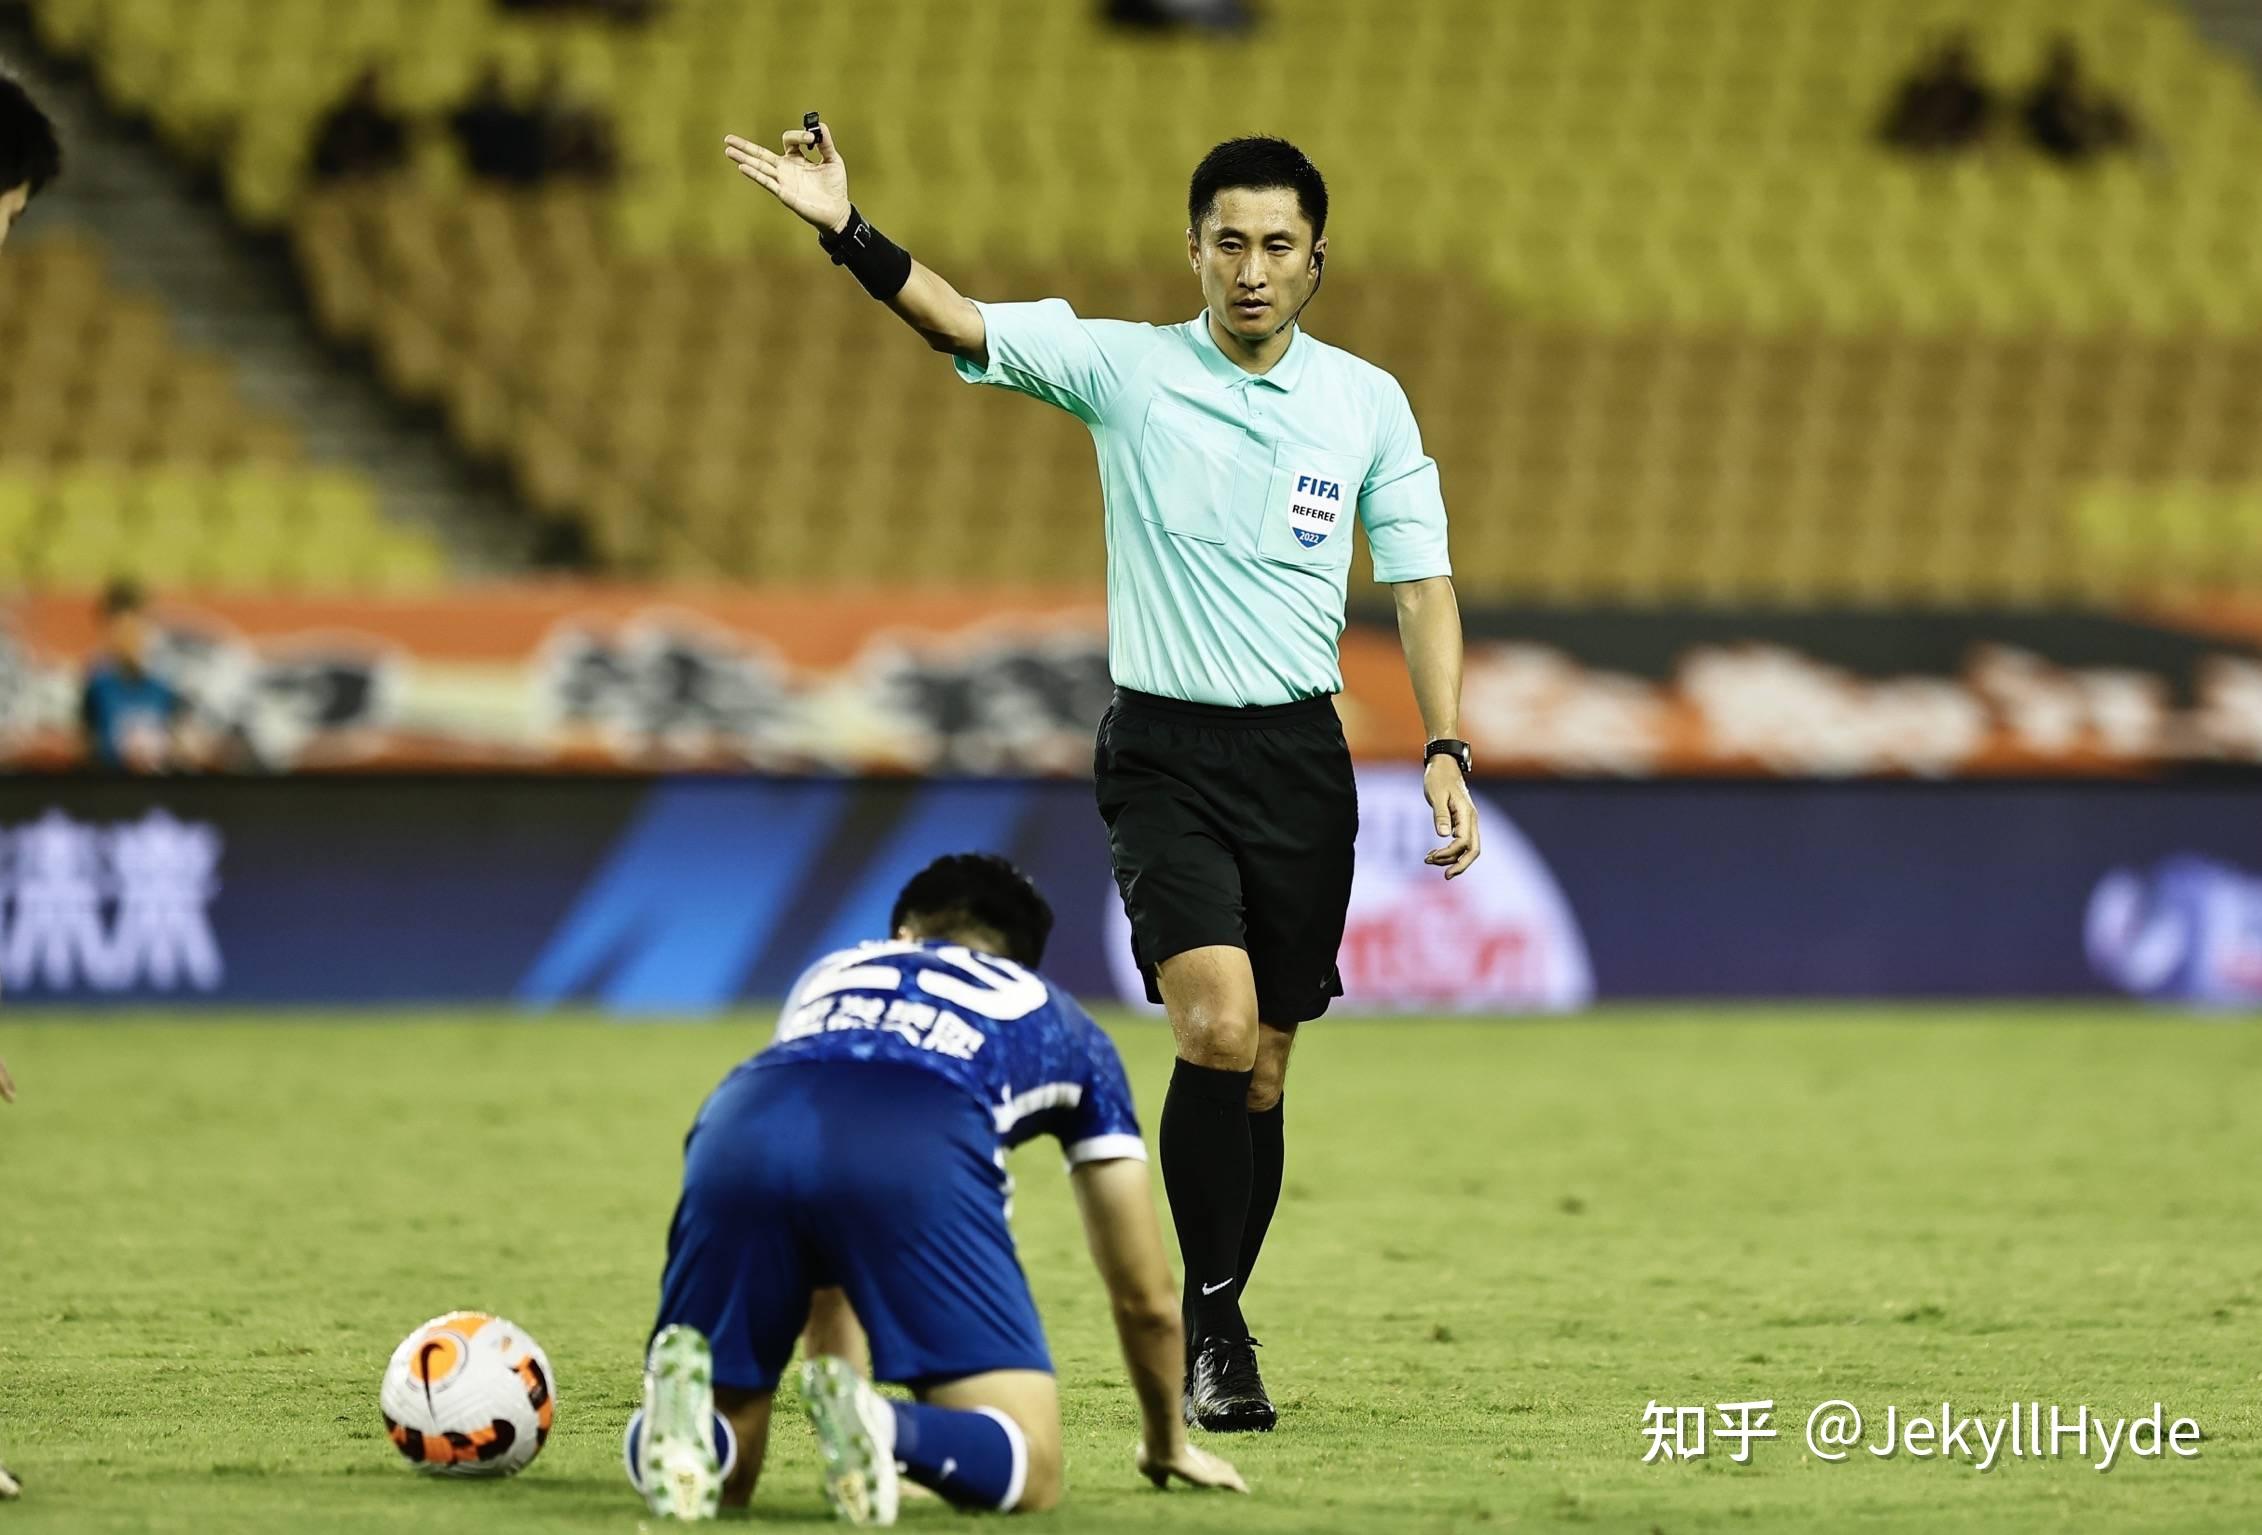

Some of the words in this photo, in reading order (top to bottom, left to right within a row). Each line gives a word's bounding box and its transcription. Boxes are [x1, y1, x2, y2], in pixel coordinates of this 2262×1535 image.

[1297, 475, 1340, 500] FIFA
[1292, 504, 1336, 523] REFEREE
[1299, 531, 1320, 543] 2022
